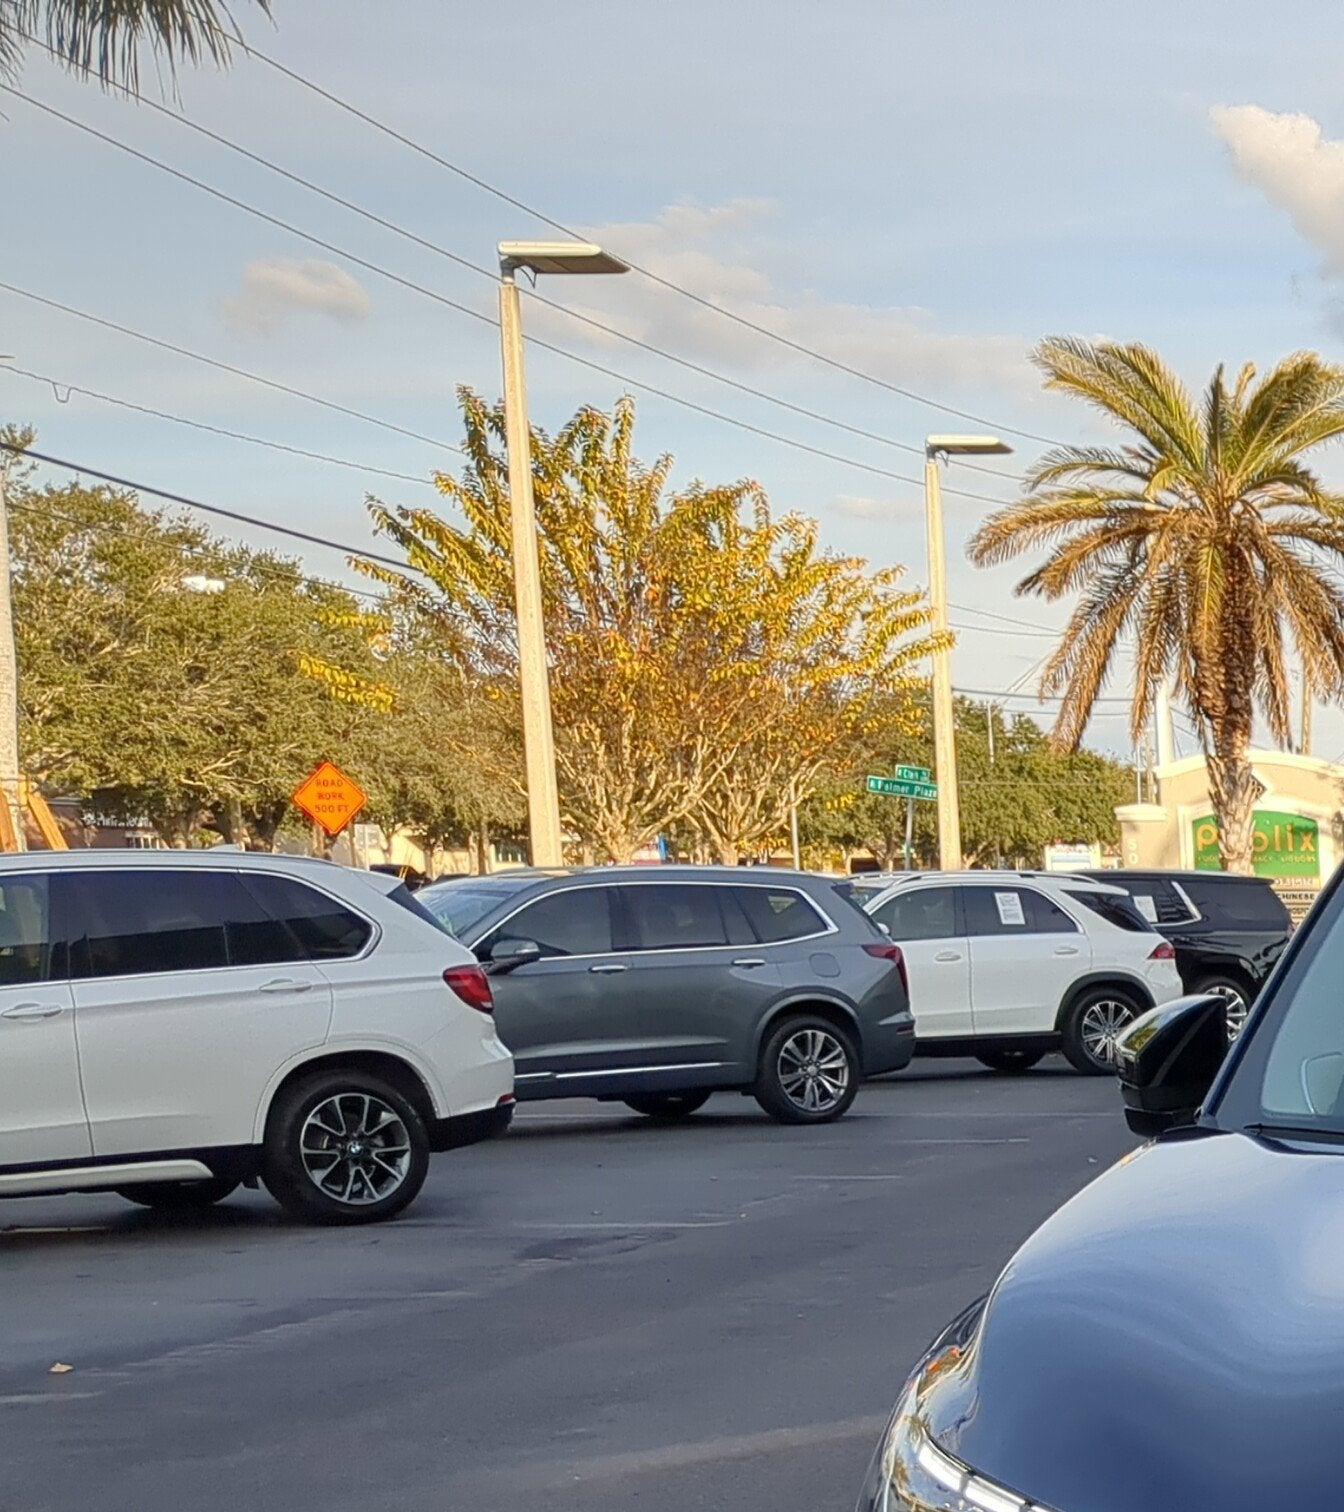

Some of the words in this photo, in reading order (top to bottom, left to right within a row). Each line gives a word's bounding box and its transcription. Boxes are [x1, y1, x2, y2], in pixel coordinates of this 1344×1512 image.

[316, 779, 343, 787] ROAD
[317, 792, 345, 801] WORK
[315, 804, 335, 813] 500
[338, 804, 350, 813] FT
